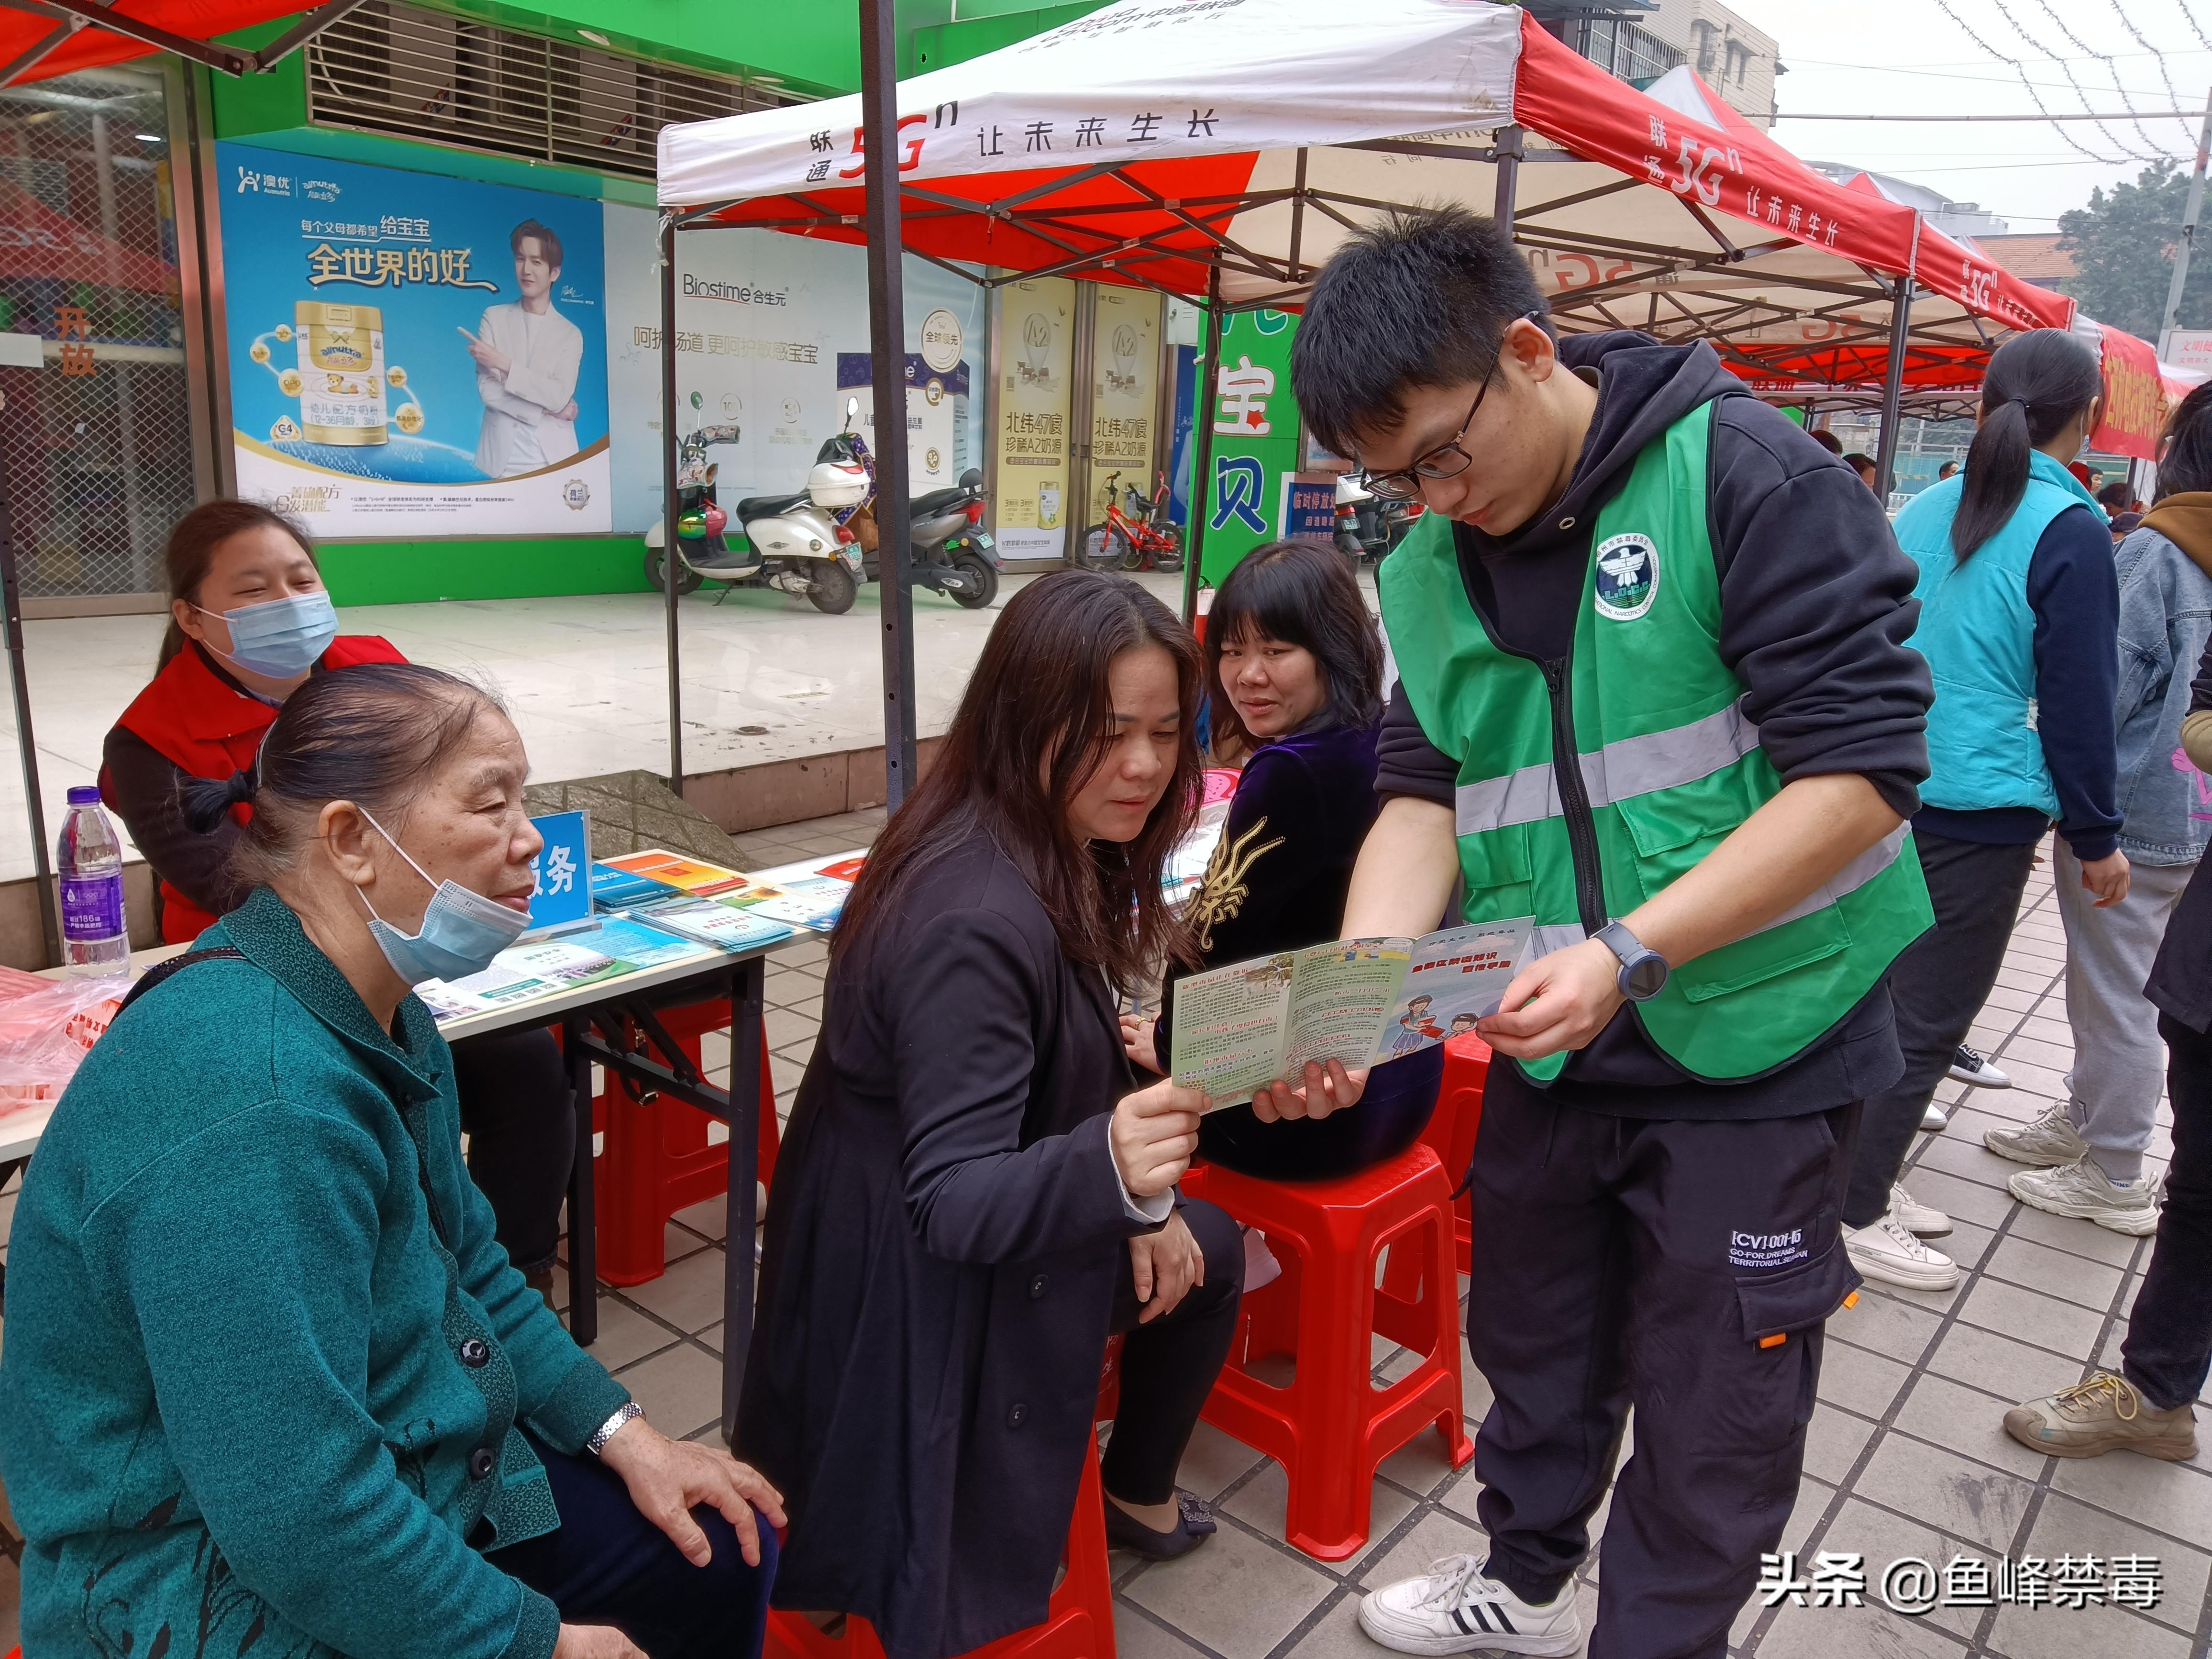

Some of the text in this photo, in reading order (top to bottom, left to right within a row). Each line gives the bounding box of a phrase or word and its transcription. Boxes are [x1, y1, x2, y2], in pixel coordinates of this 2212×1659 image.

[977, 108, 1219, 157] 让未来生长
[264, 174, 289, 189] 澳优
[301, 215, 430, 238] 每个父母都希望 给宝宝
[1747, 185, 1838, 247] 让未来生长
[307, 243, 478, 288] 全世界的好
[684, 274, 786, 306] Biostime 合生元
[54, 307, 97, 376] 开放
[707, 334, 818, 365] 更呵护敏感宝宝
[310, 403, 378, 415] 幼儿配方奶粉
[278, 424, 293, 433] G4
[1006, 411, 1063, 435] 北纬47度
[1095, 417, 1147, 438] 北纬47度
[1006, 437, 1062, 454] 珍稀A2奶源
[1094, 441, 1147, 457] 珍稀A2奶源
[1642, 591, 1655, 610] CONTROL
[1728, 1255, 1784, 1267] TERRITORIAL
[1746, 1251, 1765, 1260] FOR
[1766, 1247, 1795, 1260] DREAMS
